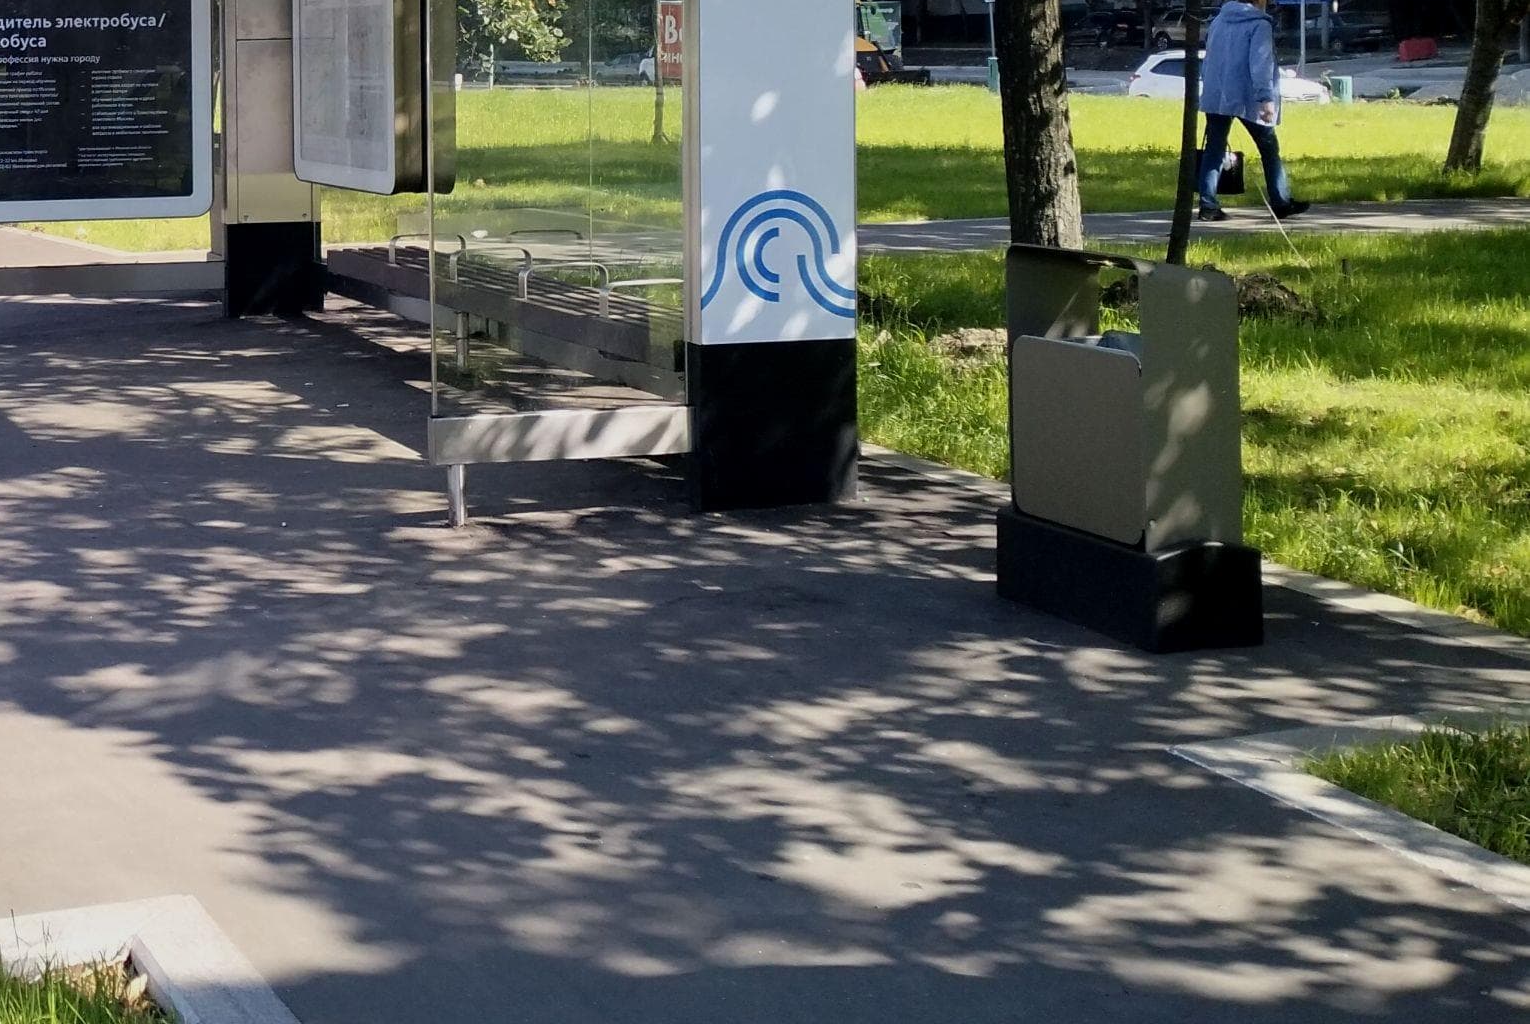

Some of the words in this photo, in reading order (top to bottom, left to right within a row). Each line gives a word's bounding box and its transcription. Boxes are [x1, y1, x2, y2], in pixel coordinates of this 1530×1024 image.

[55, 12, 167, 31] электробуса/
[41, 55, 69, 64] нужна
[70, 54, 101, 64] городу
